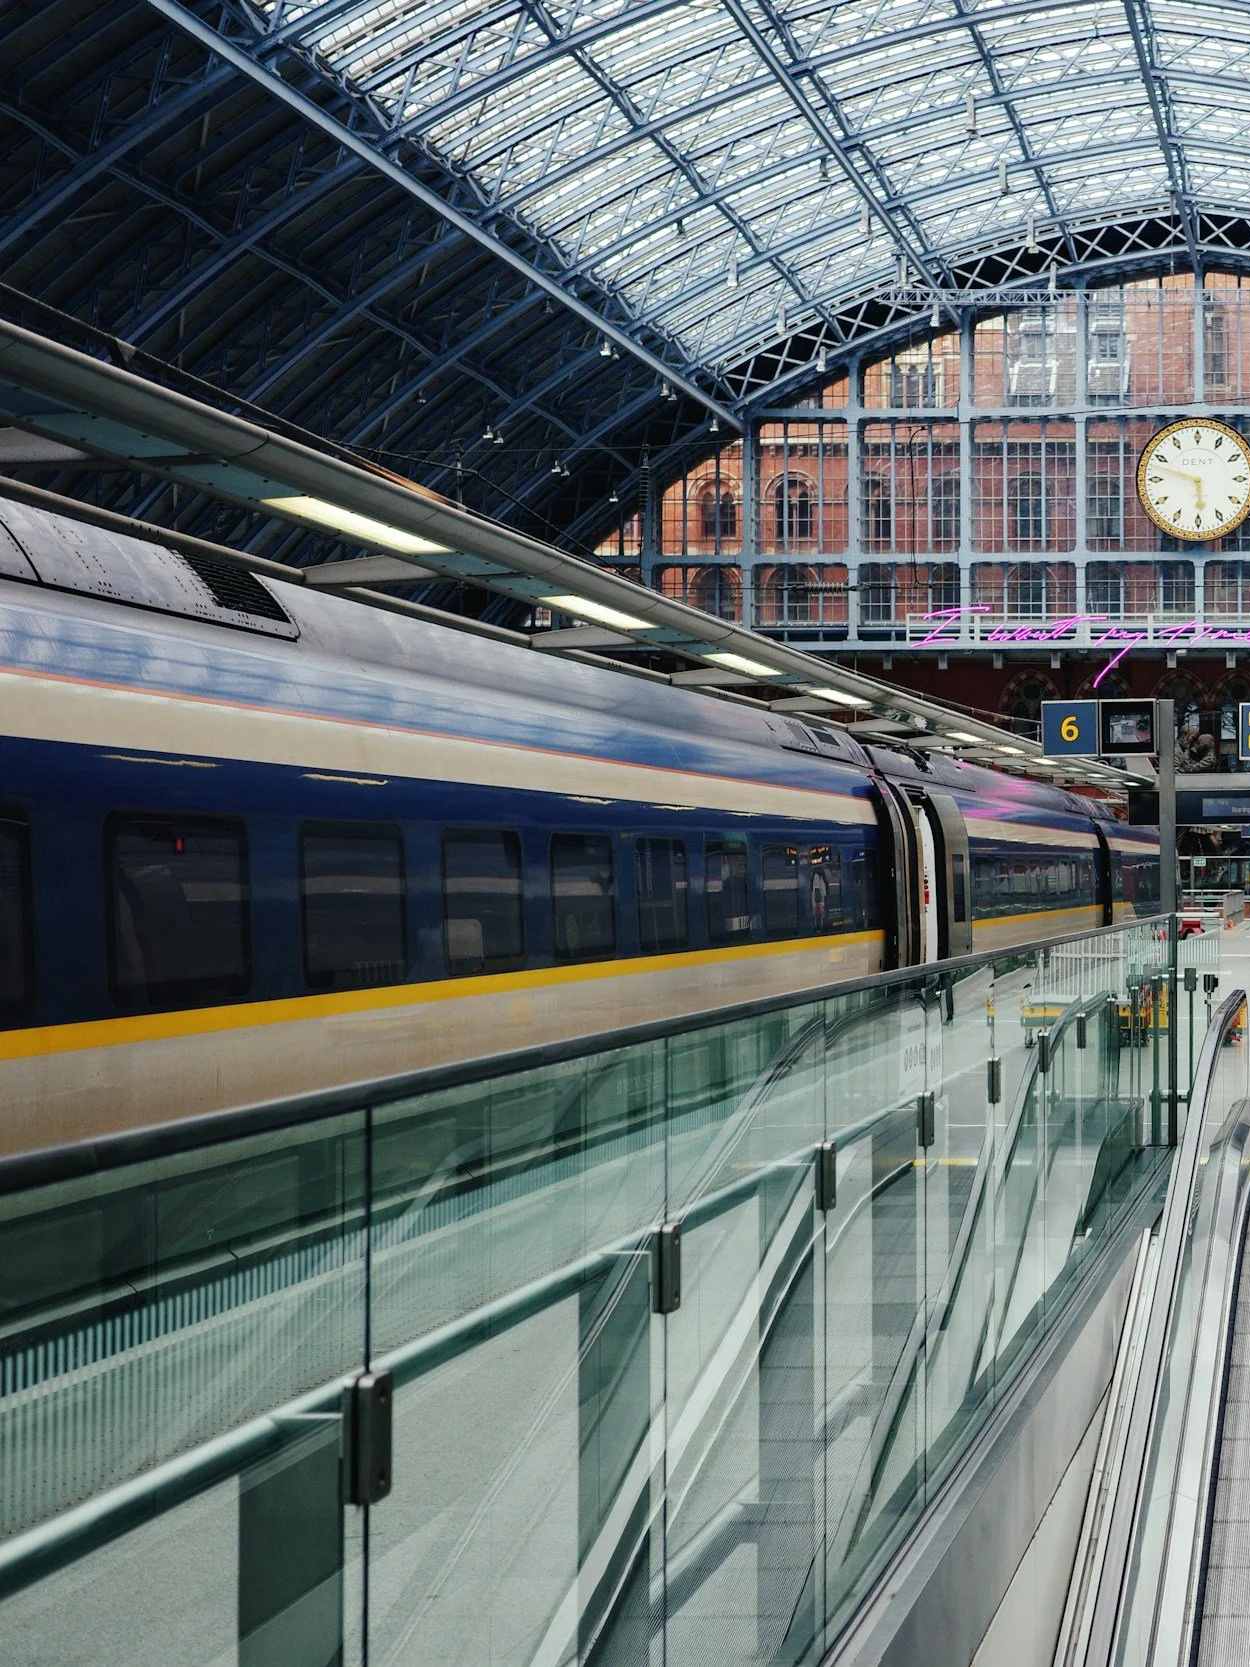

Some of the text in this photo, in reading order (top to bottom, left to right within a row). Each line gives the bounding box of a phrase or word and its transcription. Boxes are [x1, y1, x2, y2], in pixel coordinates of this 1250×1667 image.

[1182, 458, 1214, 466] DENT
[910, 606, 990, 648] I
[988, 613, 1108, 643] want
[1092, 626, 1149, 689] my
[1061, 715, 1079, 742] 6
